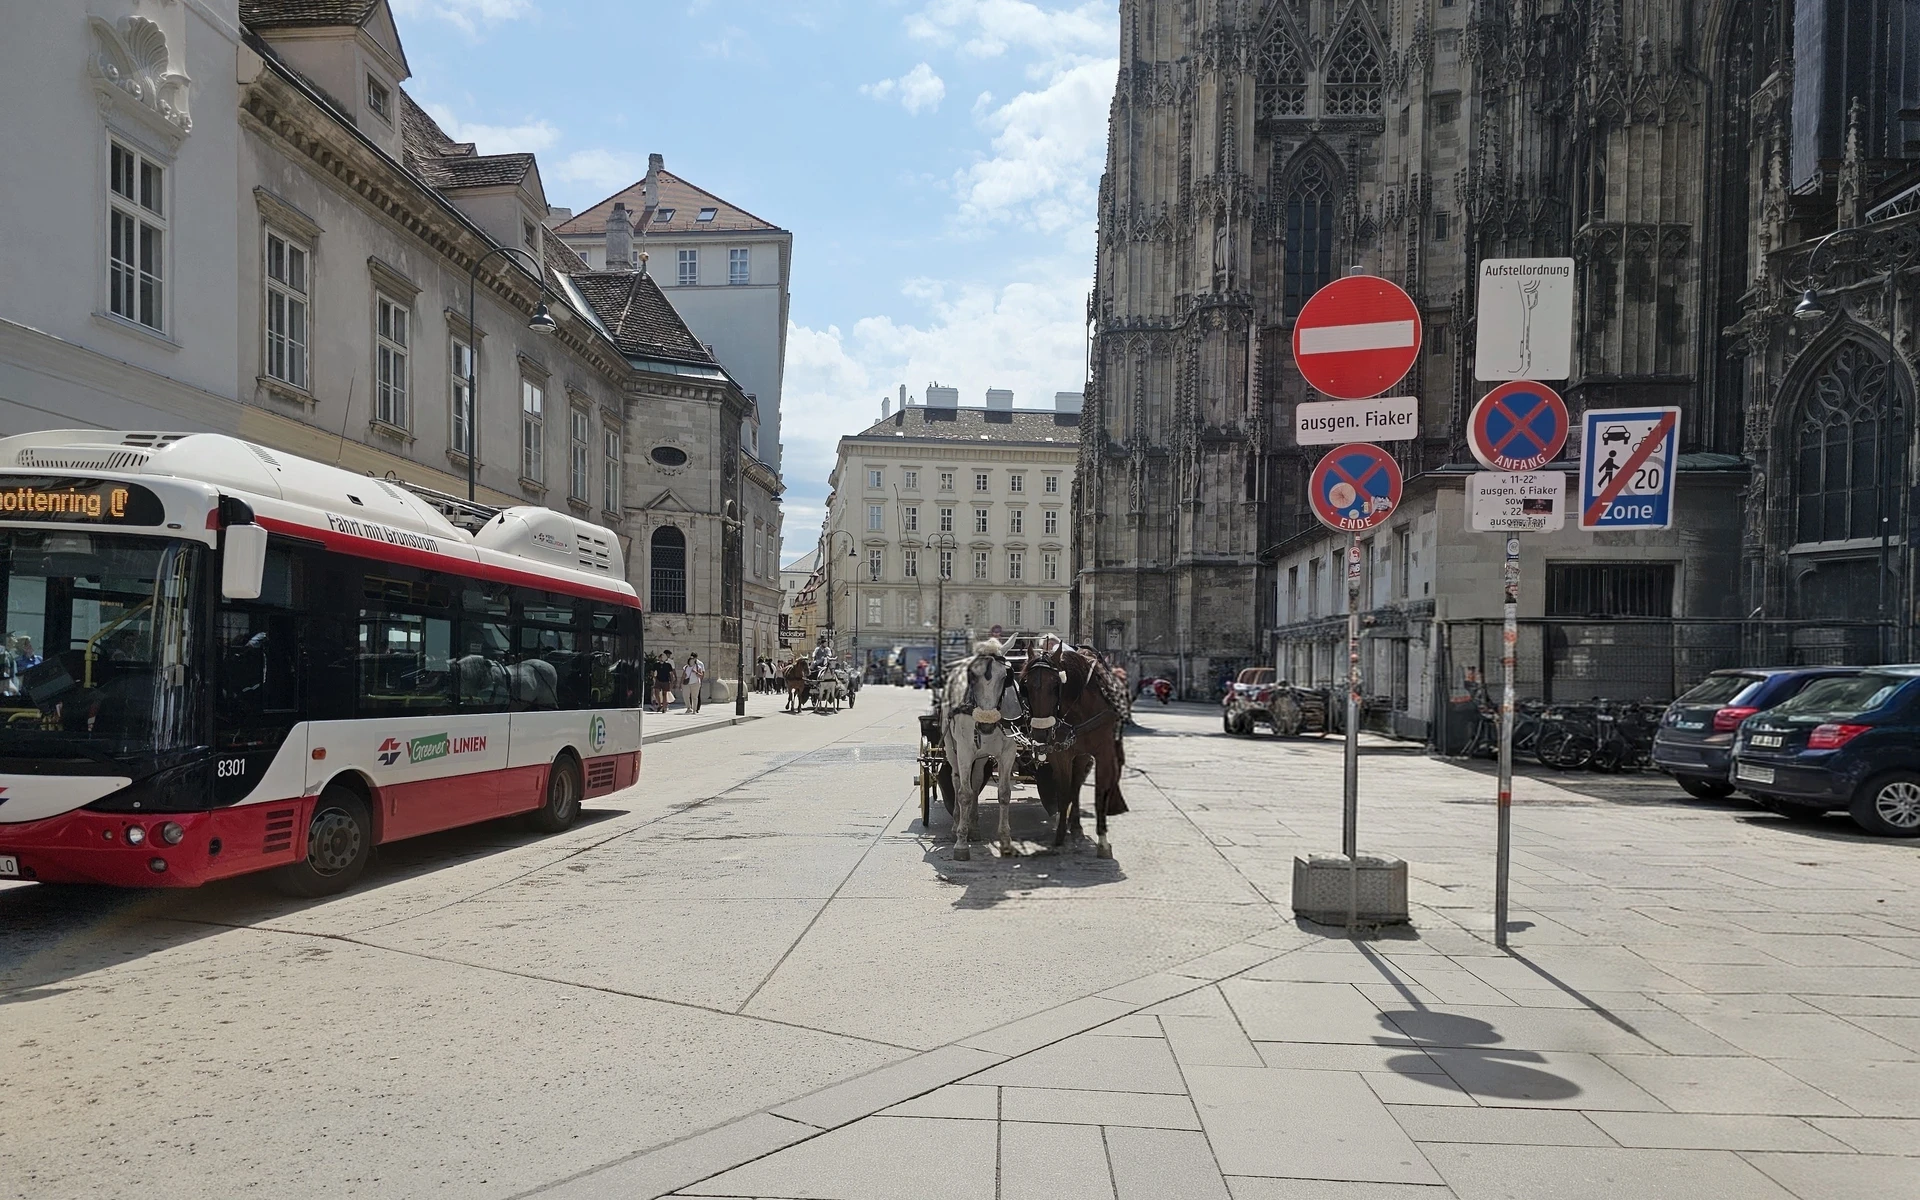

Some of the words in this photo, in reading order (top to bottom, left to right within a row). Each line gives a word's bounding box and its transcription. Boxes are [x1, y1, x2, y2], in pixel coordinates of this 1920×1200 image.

[1485, 264, 1570, 278] Aufstellordnung
[1300, 415, 1360, 433] ausgen.
[1365, 410, 1413, 427] Fiaker
[1494, 453, 1546, 470] ANFANG
[1634, 468, 1660, 490] 20
[1480, 487, 1517, 497] ausgen.
[1519, 486, 1526, 495] 6
[1528, 486, 1558, 495] Fiaker
[0, 487, 101, 517] ottenring
[1600, 501, 1654, 520] Zone
[325, 511, 363, 537] Fährt
[363, 522, 384, 542] mit
[383, 525, 439, 553] Grünstrom
[1339, 516, 1373, 529] ENDE
[412, 740, 446, 761] Greener
[453, 735, 487, 754] LINIEN
[217, 758, 246, 778] 8301
